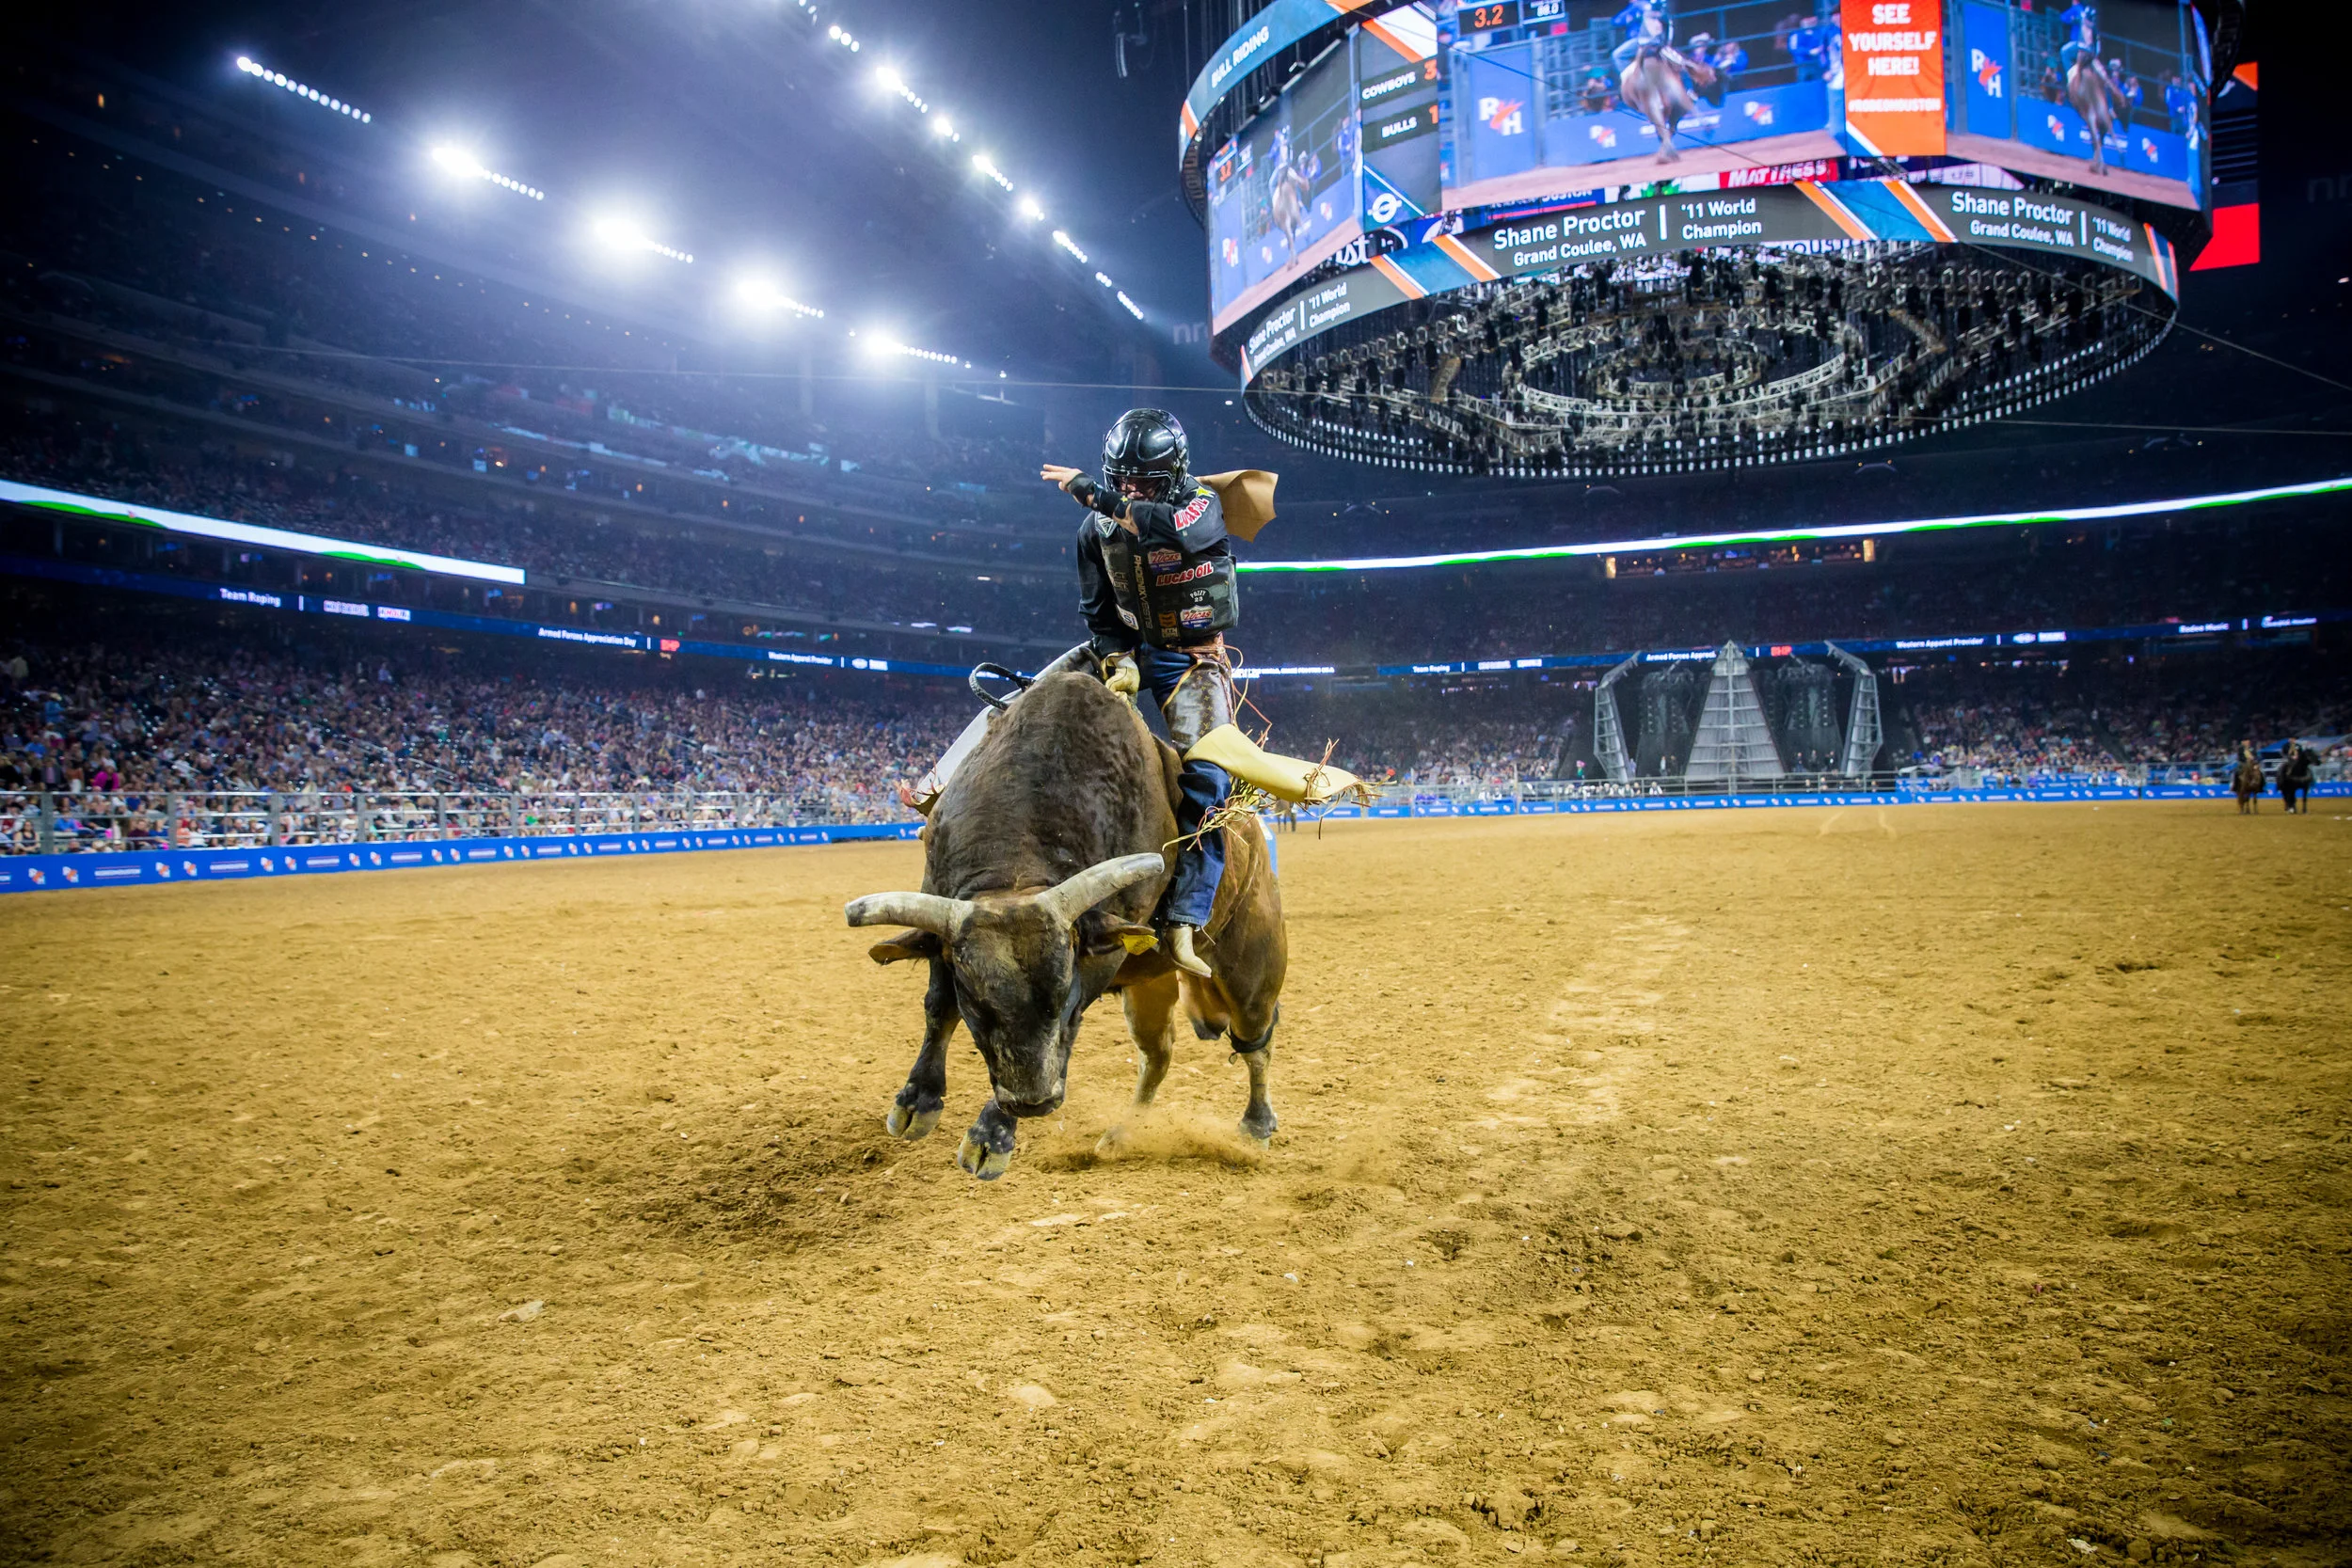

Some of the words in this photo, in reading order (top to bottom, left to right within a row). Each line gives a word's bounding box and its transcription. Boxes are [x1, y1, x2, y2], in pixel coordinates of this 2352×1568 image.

[1473, 4, 1504, 28] 3.2
[1872, 4, 1911, 24] SEE
[1848, 31, 1937, 52] YOURSELF
[1211, 57, 1232, 88] BULL
[1232, 25, 1270, 64] RIDING
[1867, 56, 1920, 76] HERE!
[1361, 71, 1417, 100] COWBOYS
[1381, 117, 1418, 138] BULLS
[1681, 202, 1704, 219] '11
[1708, 198, 1756, 216] World
[1951, 190, 2010, 216] Shane
[2013, 196, 2074, 226] Proctor
[1493, 220, 1558, 251] Shane
[1562, 208, 1646, 238] Proctor
[1681, 219, 1762, 241] Champion
[1970, 219, 2010, 237] Grand
[2011, 225, 2055, 245] Coulee,
[2055, 229, 2075, 247] WA
[1513, 245, 1558, 268] Grand
[1560, 238, 1617, 261] Coulee,
[1619, 231, 1647, 251] WA
[2092, 236, 2135, 262] Champion
[1321, 282, 1347, 304] World
[1265, 308, 1296, 339] Proctor
[1309, 301, 1351, 328] Champion
[1156, 568, 1195, 587] LUCAS
[1196, 561, 1215, 578] OIL
[219, 587, 247, 602] Team
[247, 591, 281, 608] Roping
[1184, 610, 1212, 621] LUCAS
[538, 627, 562, 639] Armed
